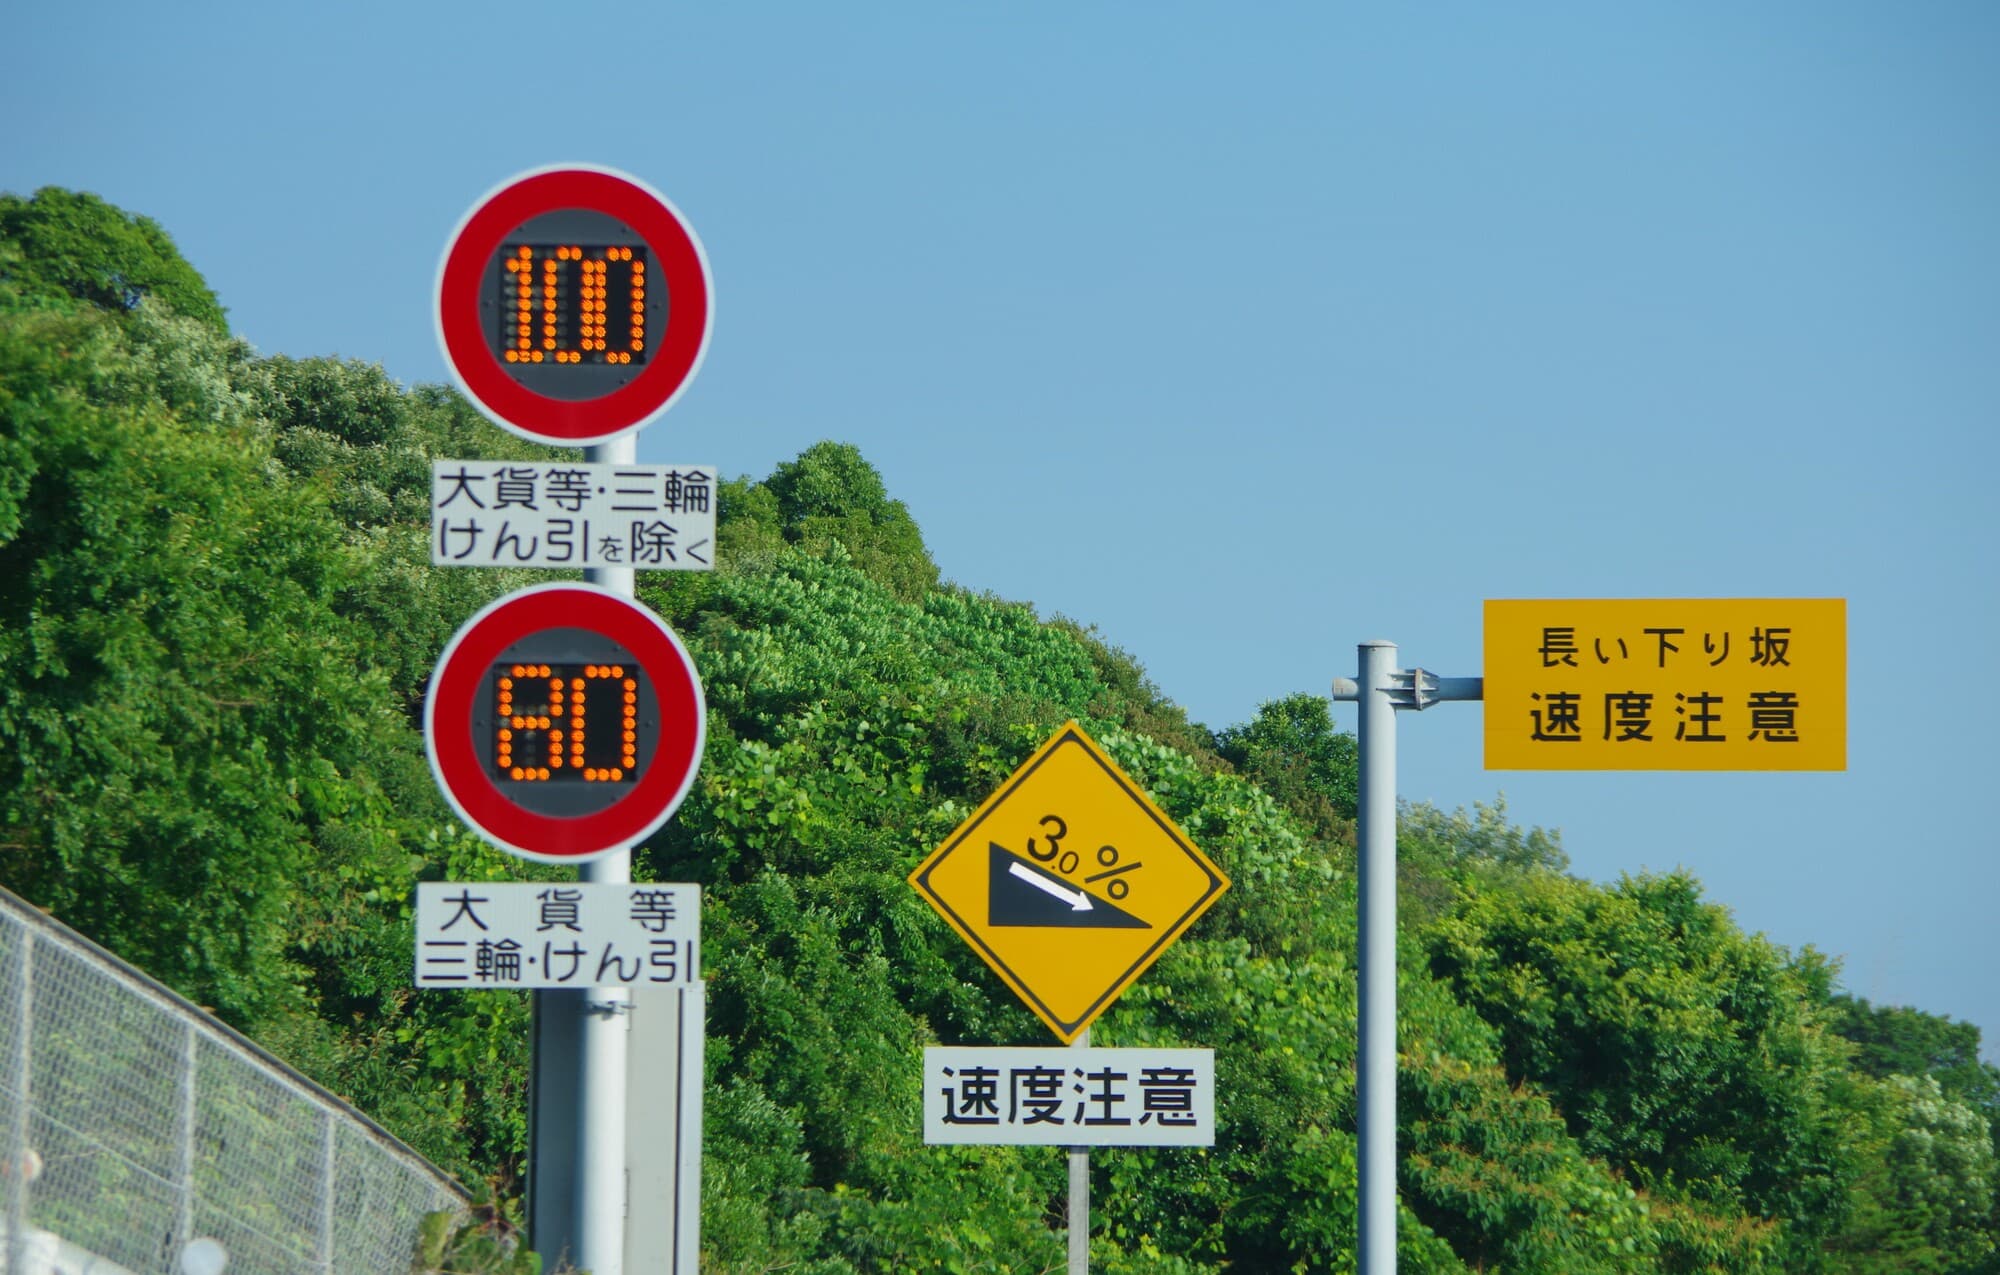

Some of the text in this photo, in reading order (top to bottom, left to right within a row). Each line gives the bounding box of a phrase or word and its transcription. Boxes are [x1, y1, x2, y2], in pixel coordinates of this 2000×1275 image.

[504, 245, 645, 364] 100
[439, 517, 710, 565] けん引を除く
[1537, 626, 1792, 668] 長い下り坂
[497, 664, 637, 782] 80
[1529, 690, 1799, 743] 速度注意
[440, 888, 677, 933] 大貨等
[941, 1064, 1198, 1128] 速度注意
